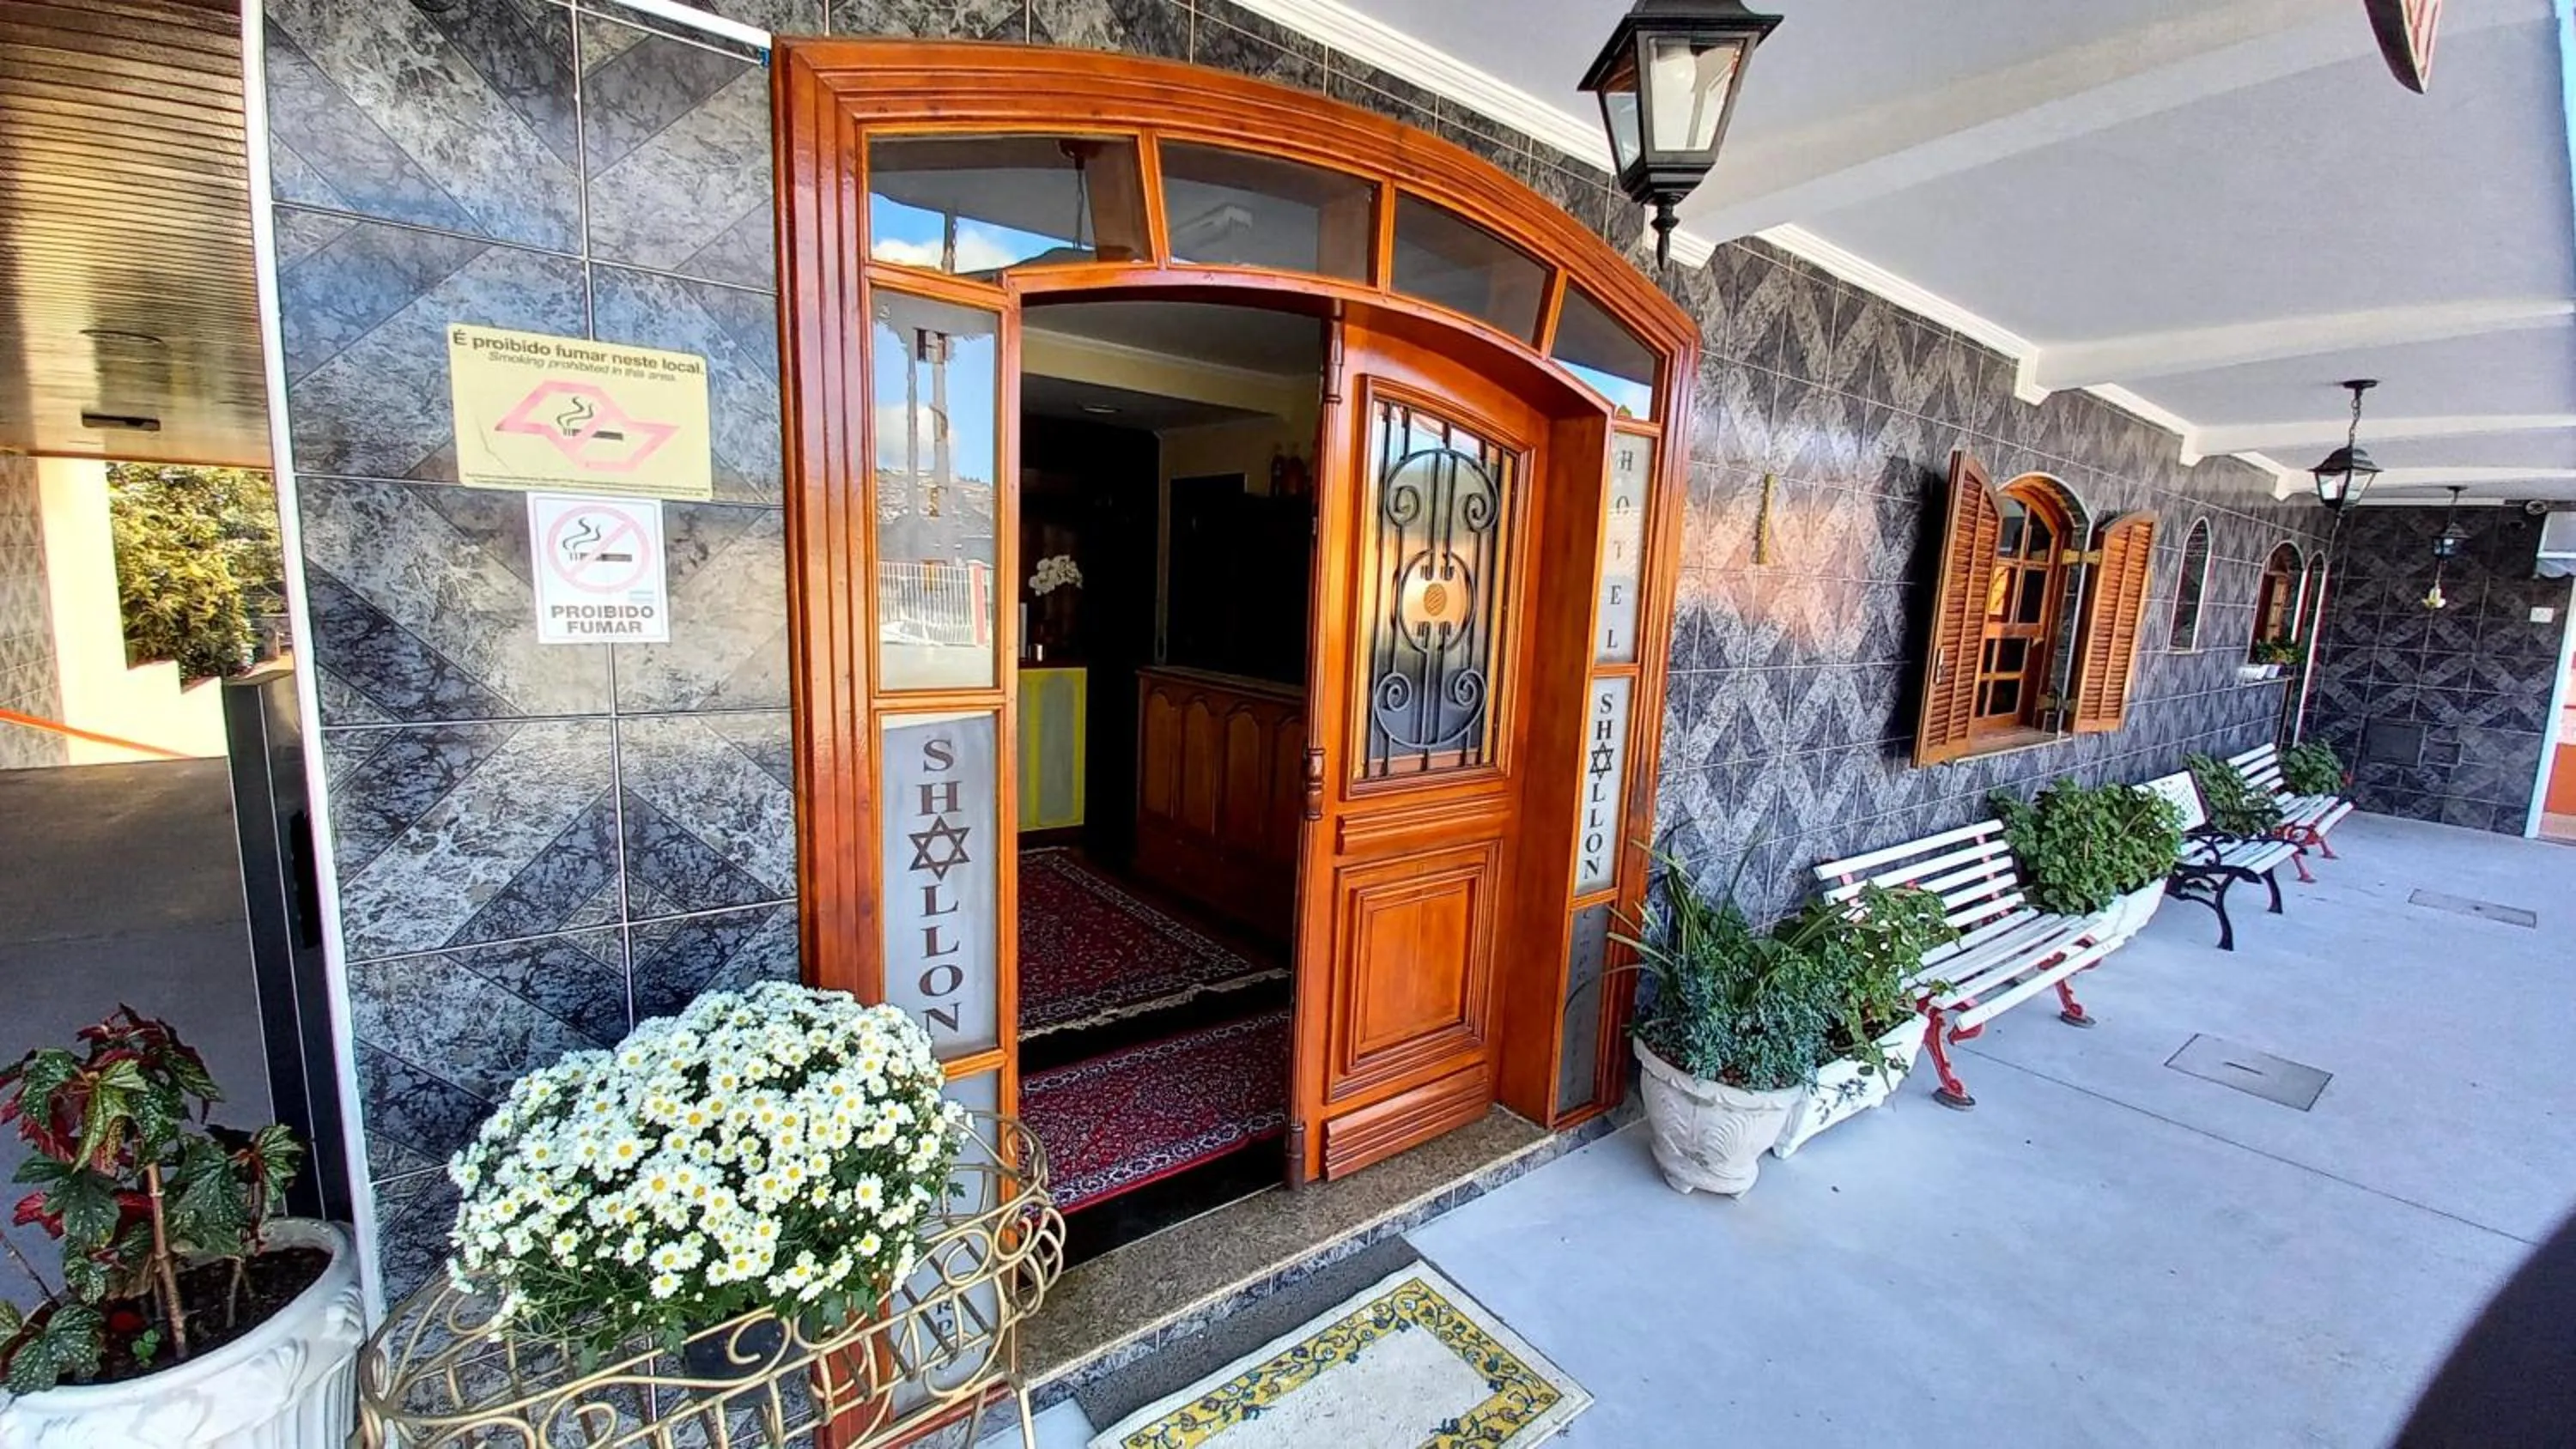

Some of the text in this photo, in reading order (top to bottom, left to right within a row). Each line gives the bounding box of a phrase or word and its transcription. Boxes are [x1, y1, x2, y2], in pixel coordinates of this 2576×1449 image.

[453, 329, 467, 345] É
[473, 336, 551, 355] proibido
[556, 343, 605, 363] fumar
[612, 354, 658, 369] neste
[489, 351, 544, 369] Smoking
[548, 358, 610, 374] prohibited
[612, 366, 623, 375] in
[1607, 449, 1634, 649] HOTEL
[550, 604, 654, 619] PROIBIDO
[567, 621, 643, 634] FUMAR
